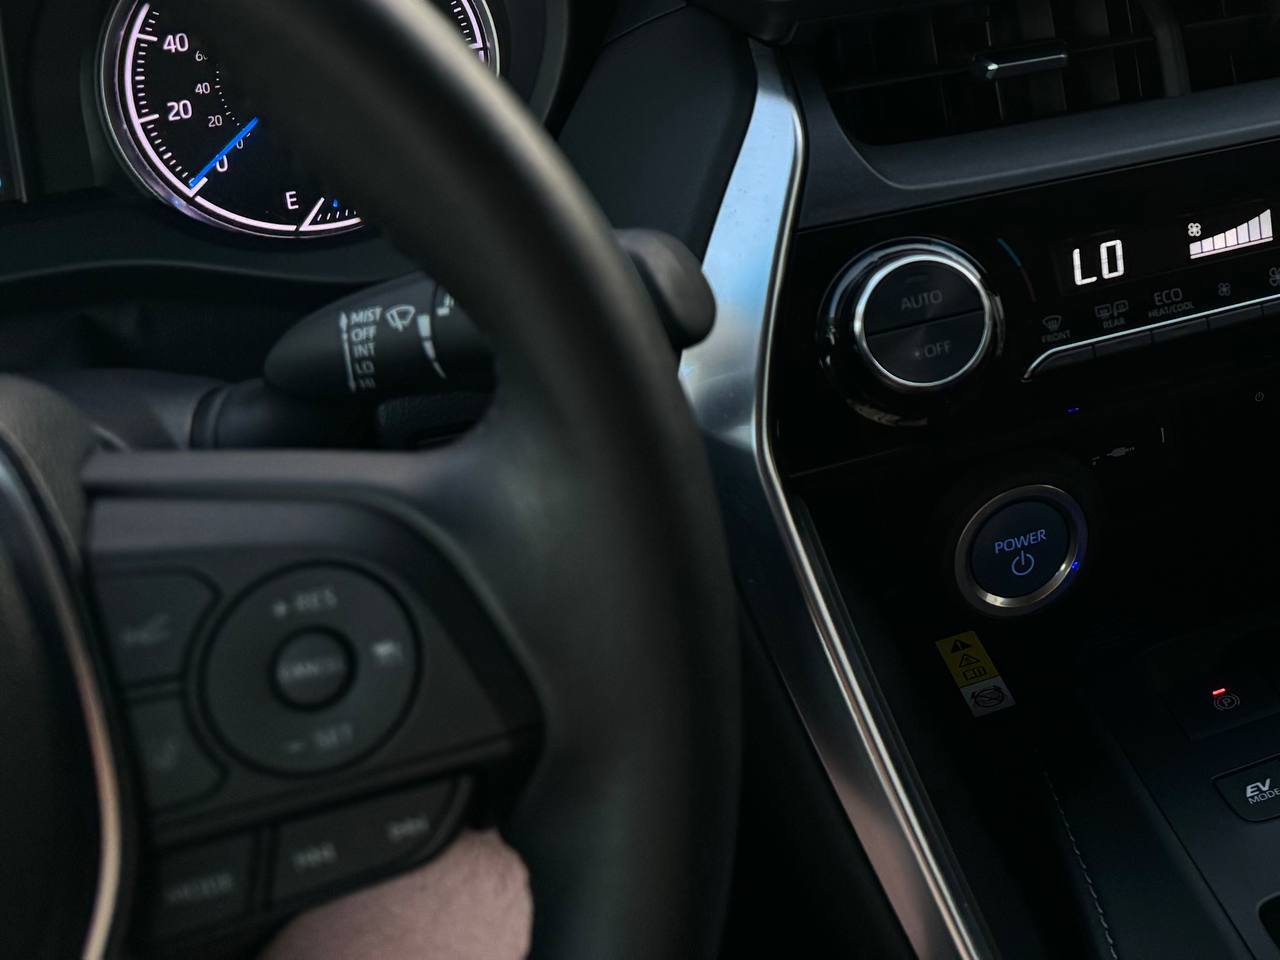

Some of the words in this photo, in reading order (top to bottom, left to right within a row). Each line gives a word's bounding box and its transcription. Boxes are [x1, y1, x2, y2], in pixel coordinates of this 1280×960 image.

[162, 32, 189, 53] 40
[194, 82, 211, 95] 40
[165, 99, 193, 122] 20
[207, 114, 223, 128] 20
[284, 190, 300, 210] E
[1072, 239, 1125, 286] LO
[901, 288, 943, 311] AUTO
[1153, 287, 1183, 306] ECO
[350, 306, 382, 325] MIST
[351, 325, 377, 342] OFF
[353, 342, 376, 358] INT
[923, 339, 952, 358] OFF
[994, 528, 1047, 554] POWER
[1245, 777, 1271, 798] EV
